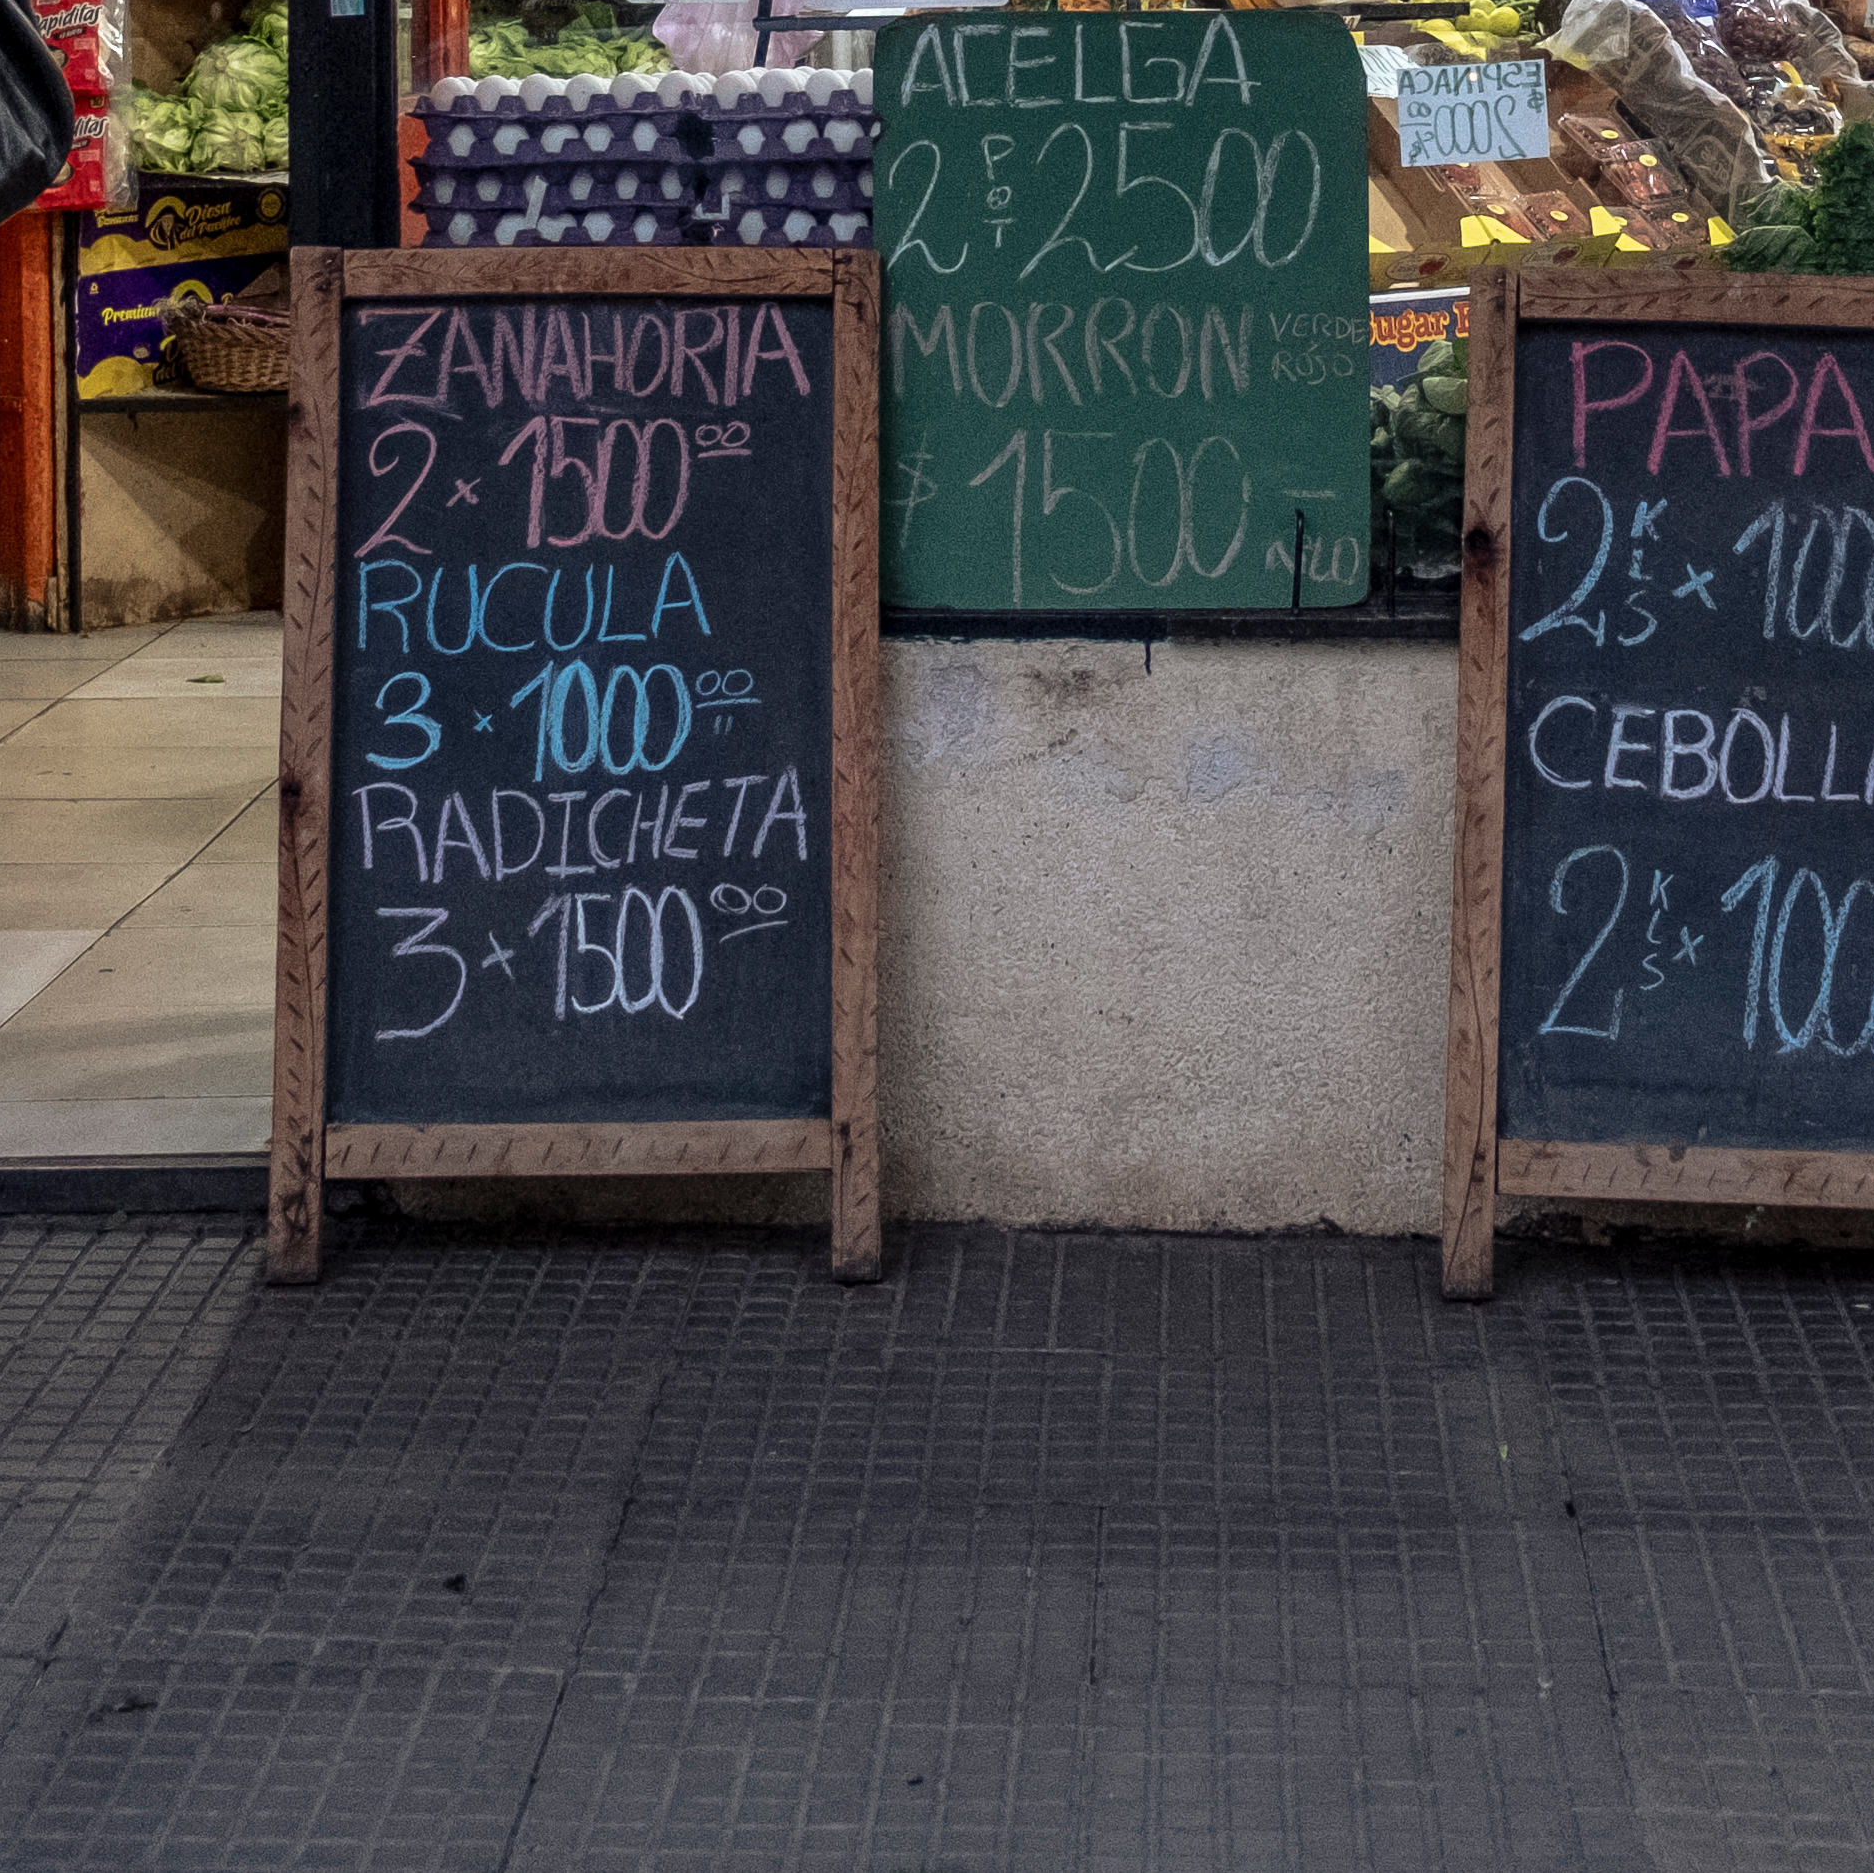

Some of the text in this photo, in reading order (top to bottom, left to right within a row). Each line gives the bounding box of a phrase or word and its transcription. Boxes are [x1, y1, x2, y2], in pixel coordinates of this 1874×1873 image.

[902, 13, 1261, 108] ACELGA
[887, 123, 1322, 280] 2 2500
[359, 303, 810, 409] ZANAHORIA
[890, 297, 1253, 408] MORRON
[355, 420, 438, 558] 2
[498, 414, 691, 550] 1500
[968, 427, 1253, 610] 1500
[357, 551, 712, 655] RUCULA
[1518, 476, 1613, 647] 2
[364, 671, 441, 771] 3
[509, 659, 693, 783] 1000
[352, 766, 810, 884] RADICHETA
[374, 906, 467, 1042] 3
[529, 885, 703, 1021] 1500
[1538, 843, 1629, 1042] 2
